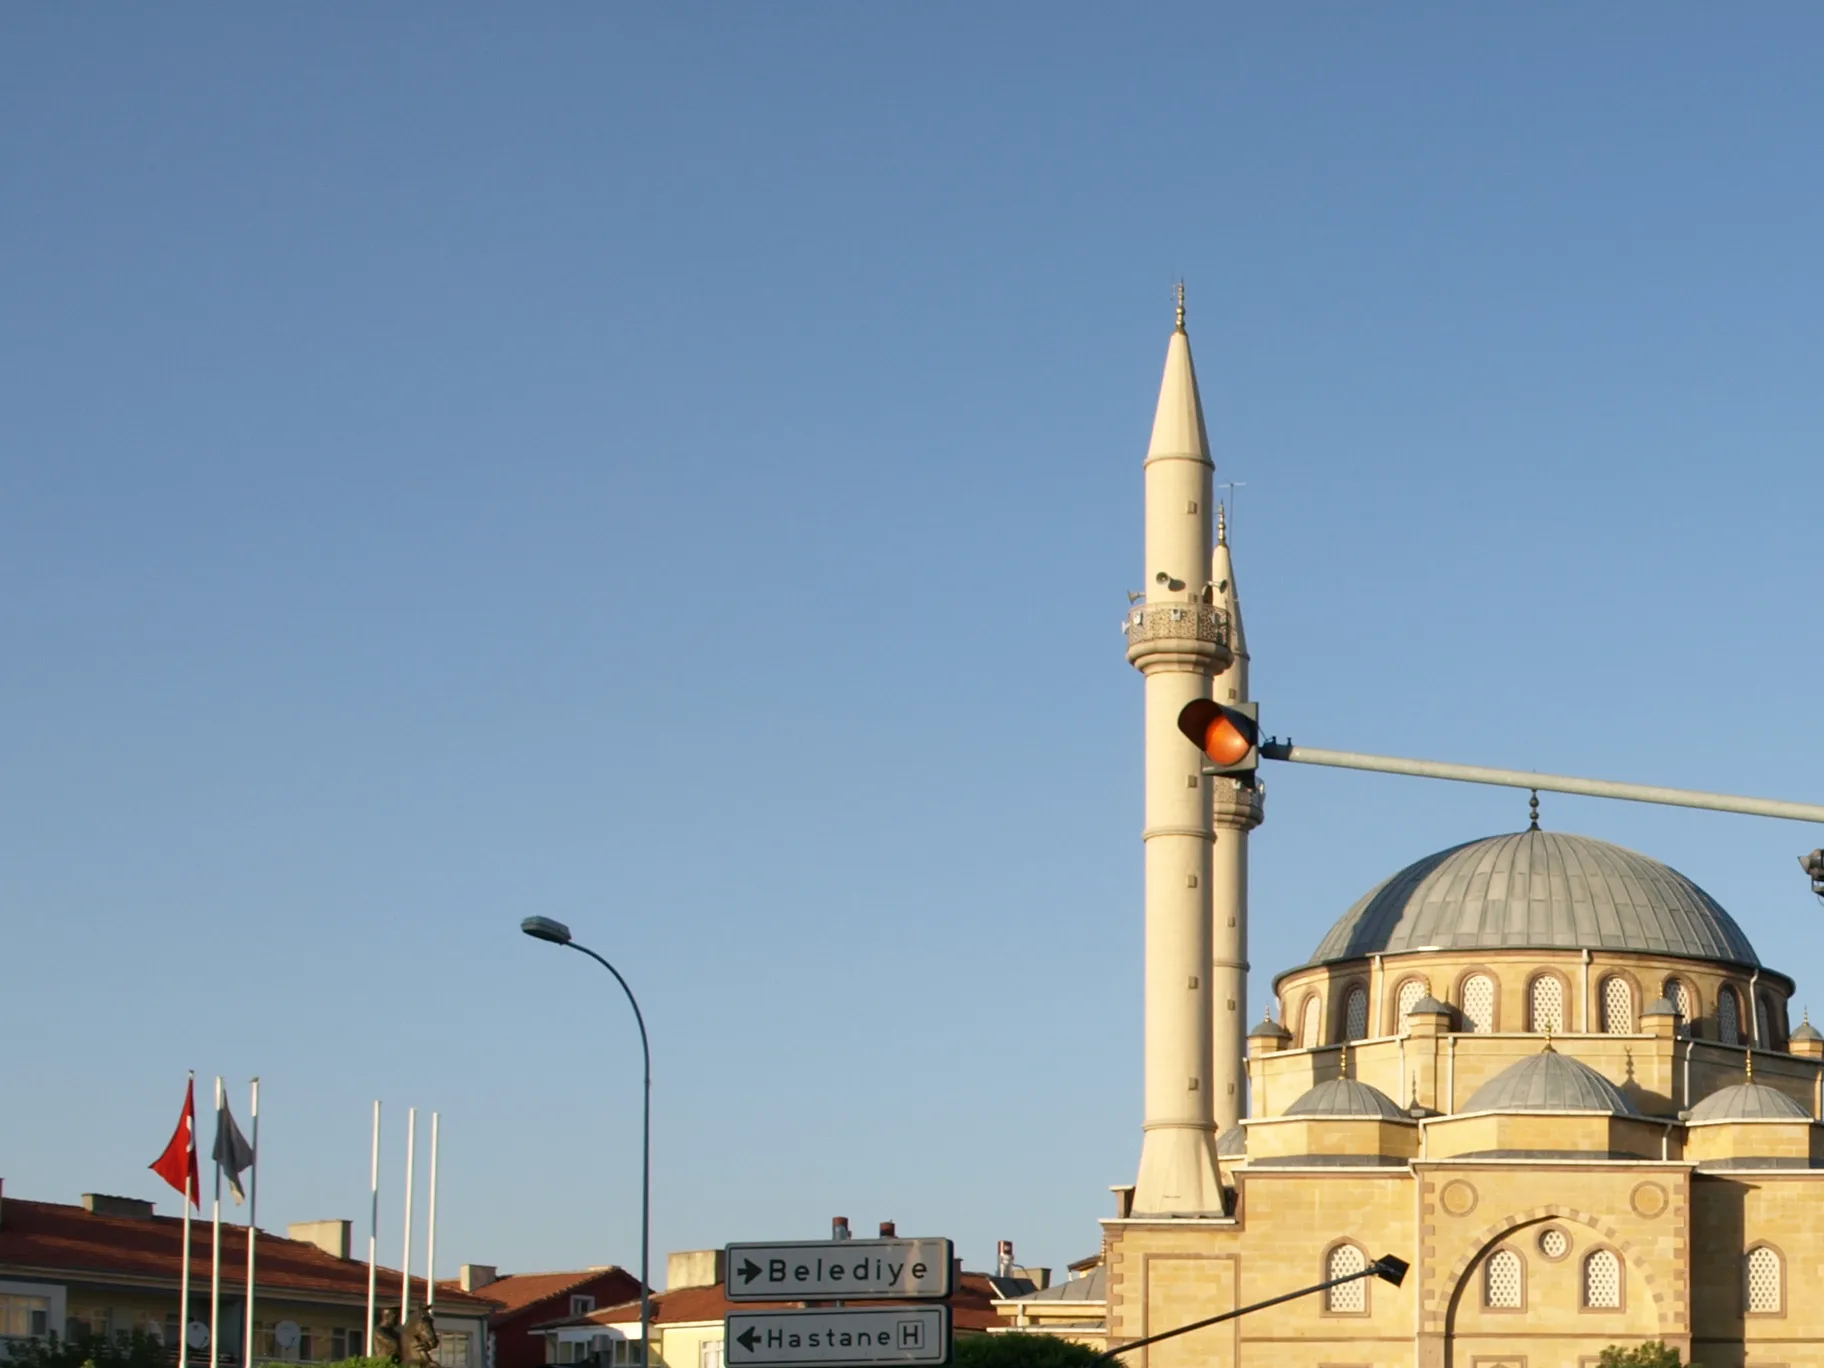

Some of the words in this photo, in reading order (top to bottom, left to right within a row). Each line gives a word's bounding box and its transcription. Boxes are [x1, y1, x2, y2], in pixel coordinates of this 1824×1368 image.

[768, 1257, 928, 1286] Belediye
[767, 1328, 891, 1348] Hastane
[902, 1325, 919, 1346] H
